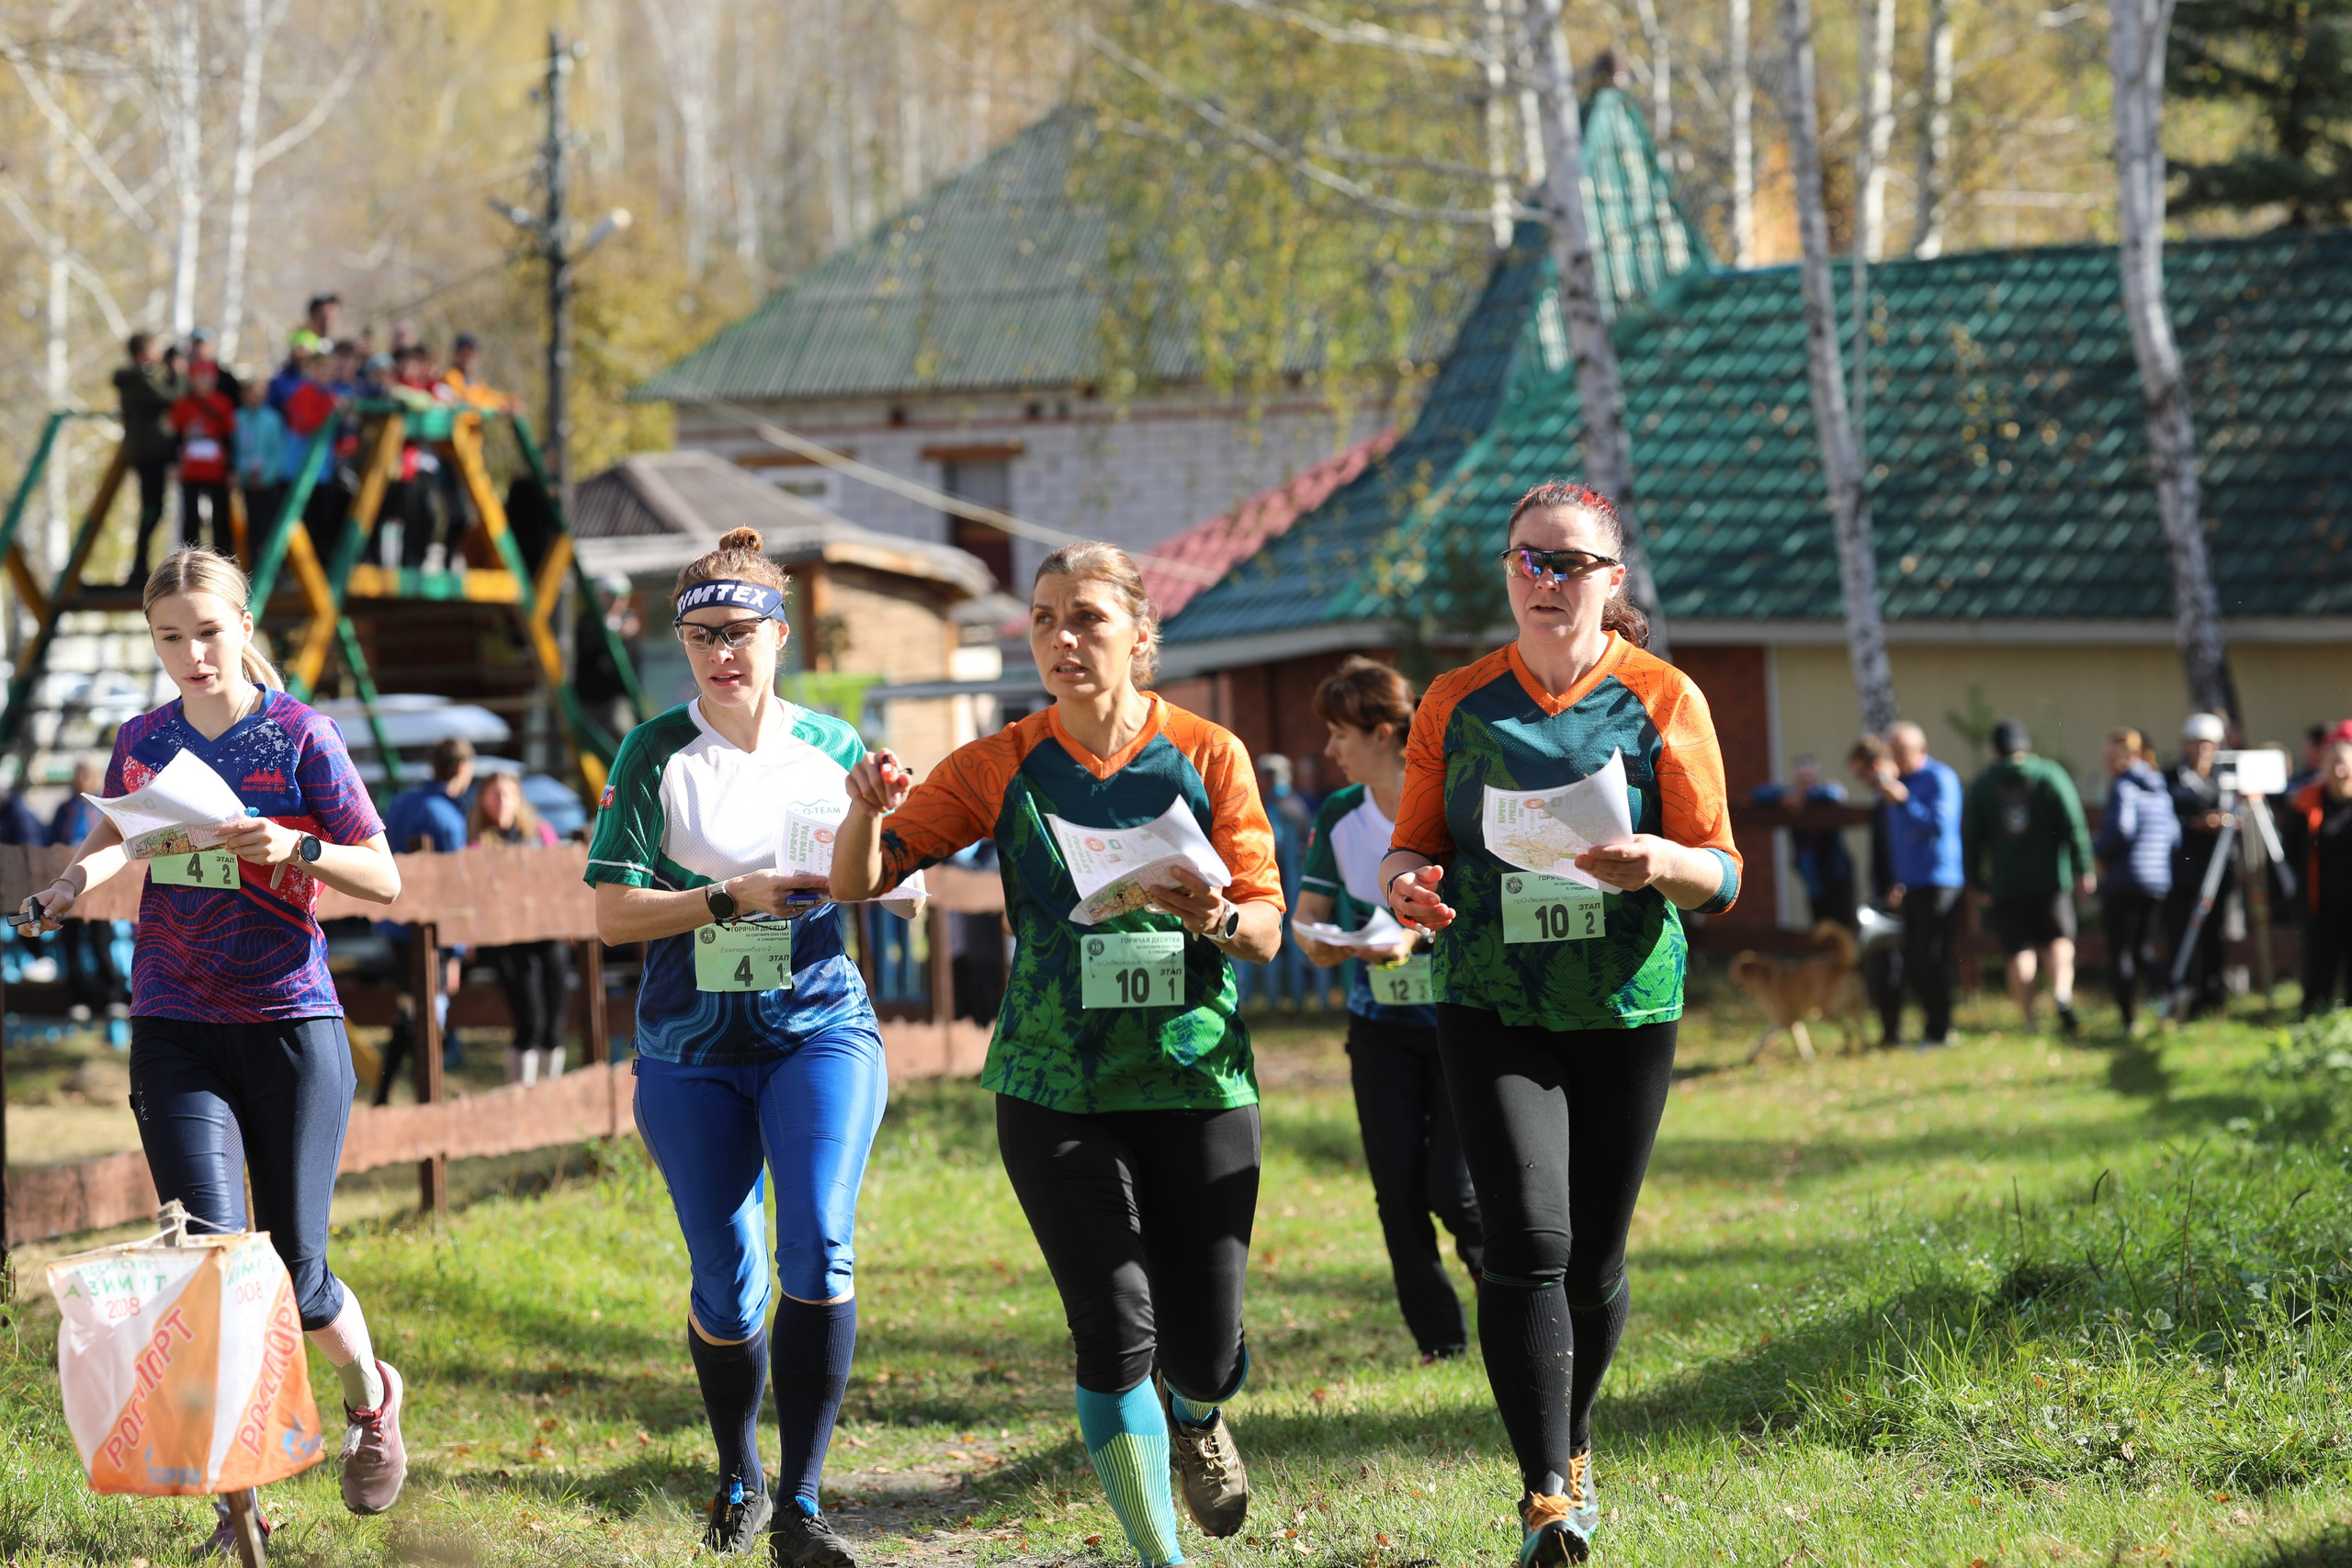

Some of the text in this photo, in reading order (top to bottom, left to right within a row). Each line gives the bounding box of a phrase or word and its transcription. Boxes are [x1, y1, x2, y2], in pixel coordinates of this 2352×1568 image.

[187, 853, 204, 883] 4
[216, 855, 235, 863] ЭТАП
[222, 863, 232, 885] 2
[1534, 904, 1569, 939] 10
[1585, 911, 1595, 934] 2
[720, 945, 772, 953] Екатеринбург-2
[734, 955, 753, 987] 4
[776, 963, 784, 985] 1
[1115, 967, 1149, 1003] 10
[1168, 977, 1175, 1001] 1
[1389, 979, 1409, 1000] 12
